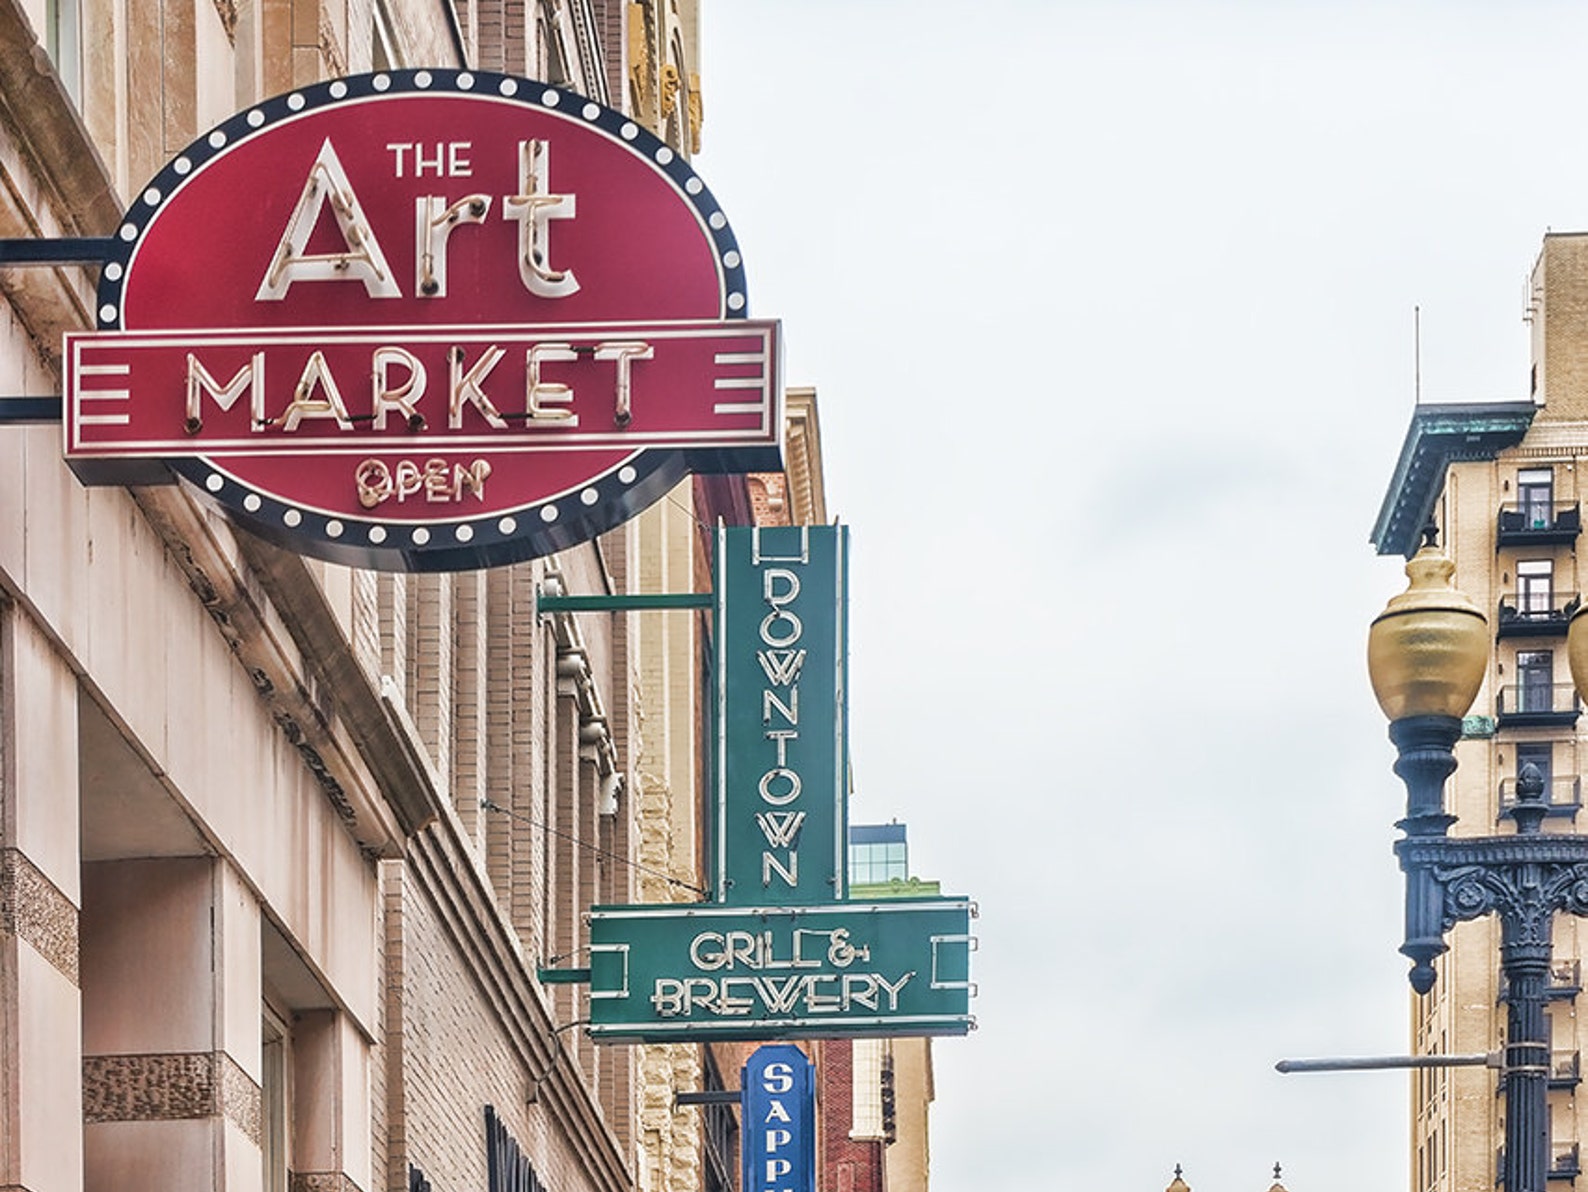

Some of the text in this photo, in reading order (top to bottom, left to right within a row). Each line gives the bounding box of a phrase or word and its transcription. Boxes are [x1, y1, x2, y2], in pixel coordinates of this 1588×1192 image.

[386, 142, 472, 178] THE
[254, 136, 581, 300] Art
[185, 341, 655, 433] MARKET
[354, 457, 493, 510] OPEN
[755, 568, 807, 889] DOWNTOWN
[690, 928, 870, 969] GRILL &
[651, 971, 916, 1016] BREWERY
